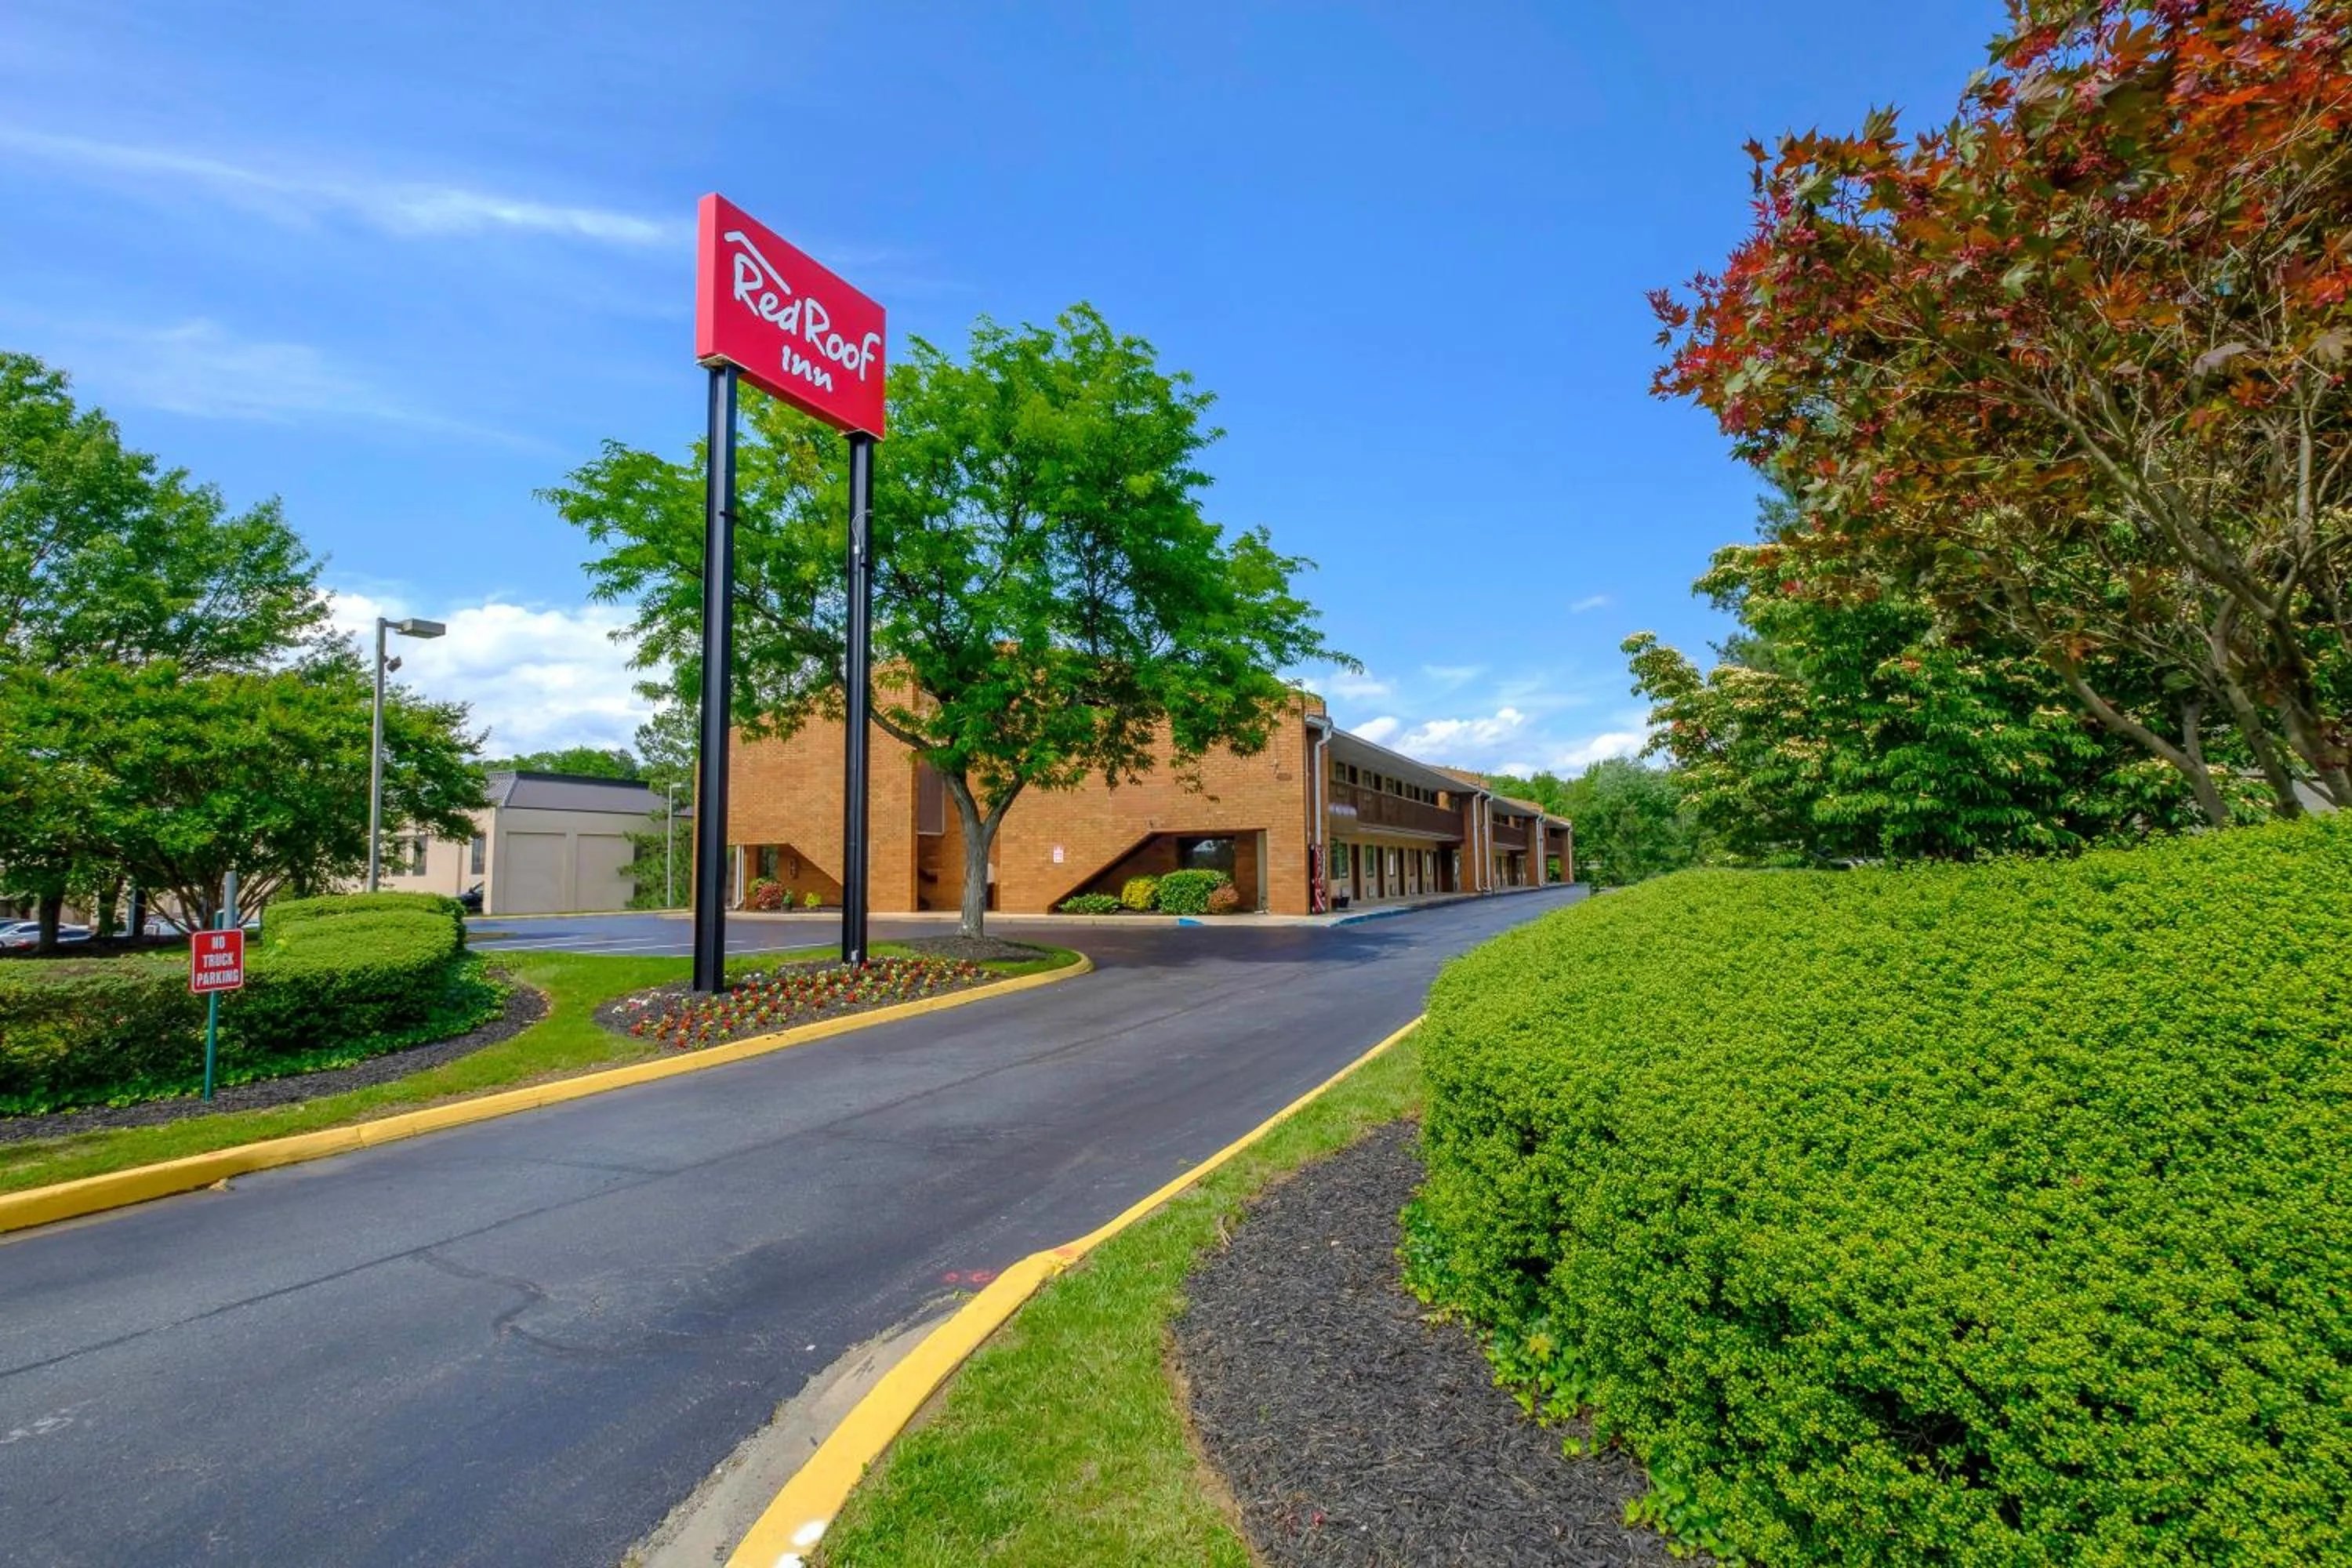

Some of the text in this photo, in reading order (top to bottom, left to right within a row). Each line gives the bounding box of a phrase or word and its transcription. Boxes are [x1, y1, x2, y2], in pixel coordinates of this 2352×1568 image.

[212, 936, 226, 949] NO
[202, 952, 234, 968] TRUCK
[196, 968, 239, 987] PARKING
